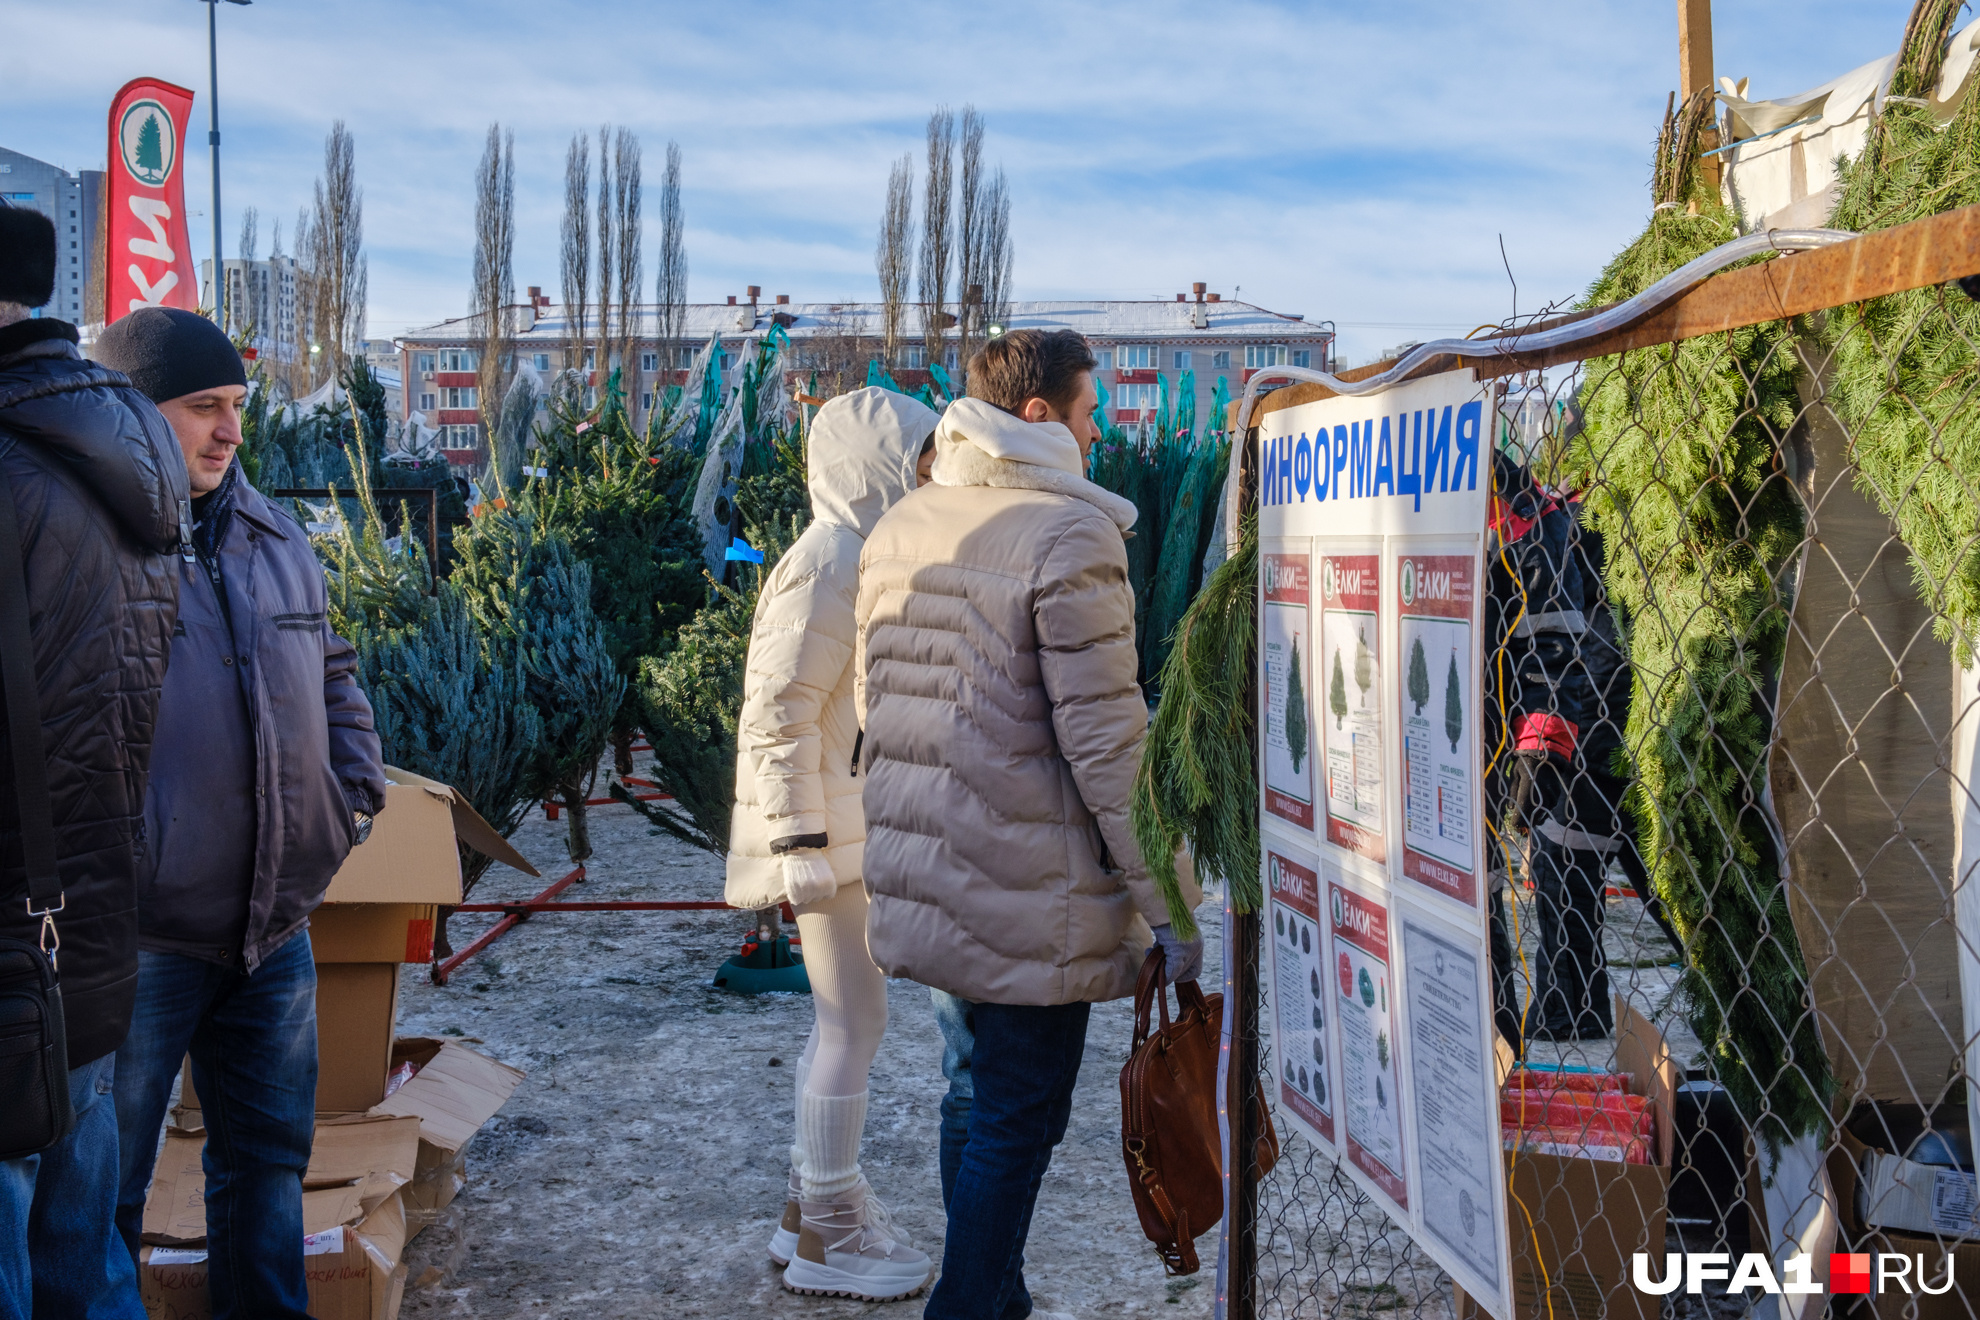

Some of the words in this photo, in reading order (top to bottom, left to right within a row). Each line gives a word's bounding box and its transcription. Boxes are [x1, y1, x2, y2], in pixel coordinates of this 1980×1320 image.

[1263, 400, 1483, 513] ИНФОРМАЦИЯ
[1274, 560, 1295, 589] ЁЛКИ
[1335, 562, 1361, 595] ЁЛКИ
[1417, 563, 1450, 600] ЁЛКИ
[1280, 862, 1304, 900] ЁЛКИ
[1419, 860, 1459, 889] WWW.ELKI.BIZ
[1343, 895, 1371, 938] ЁЛКИ
